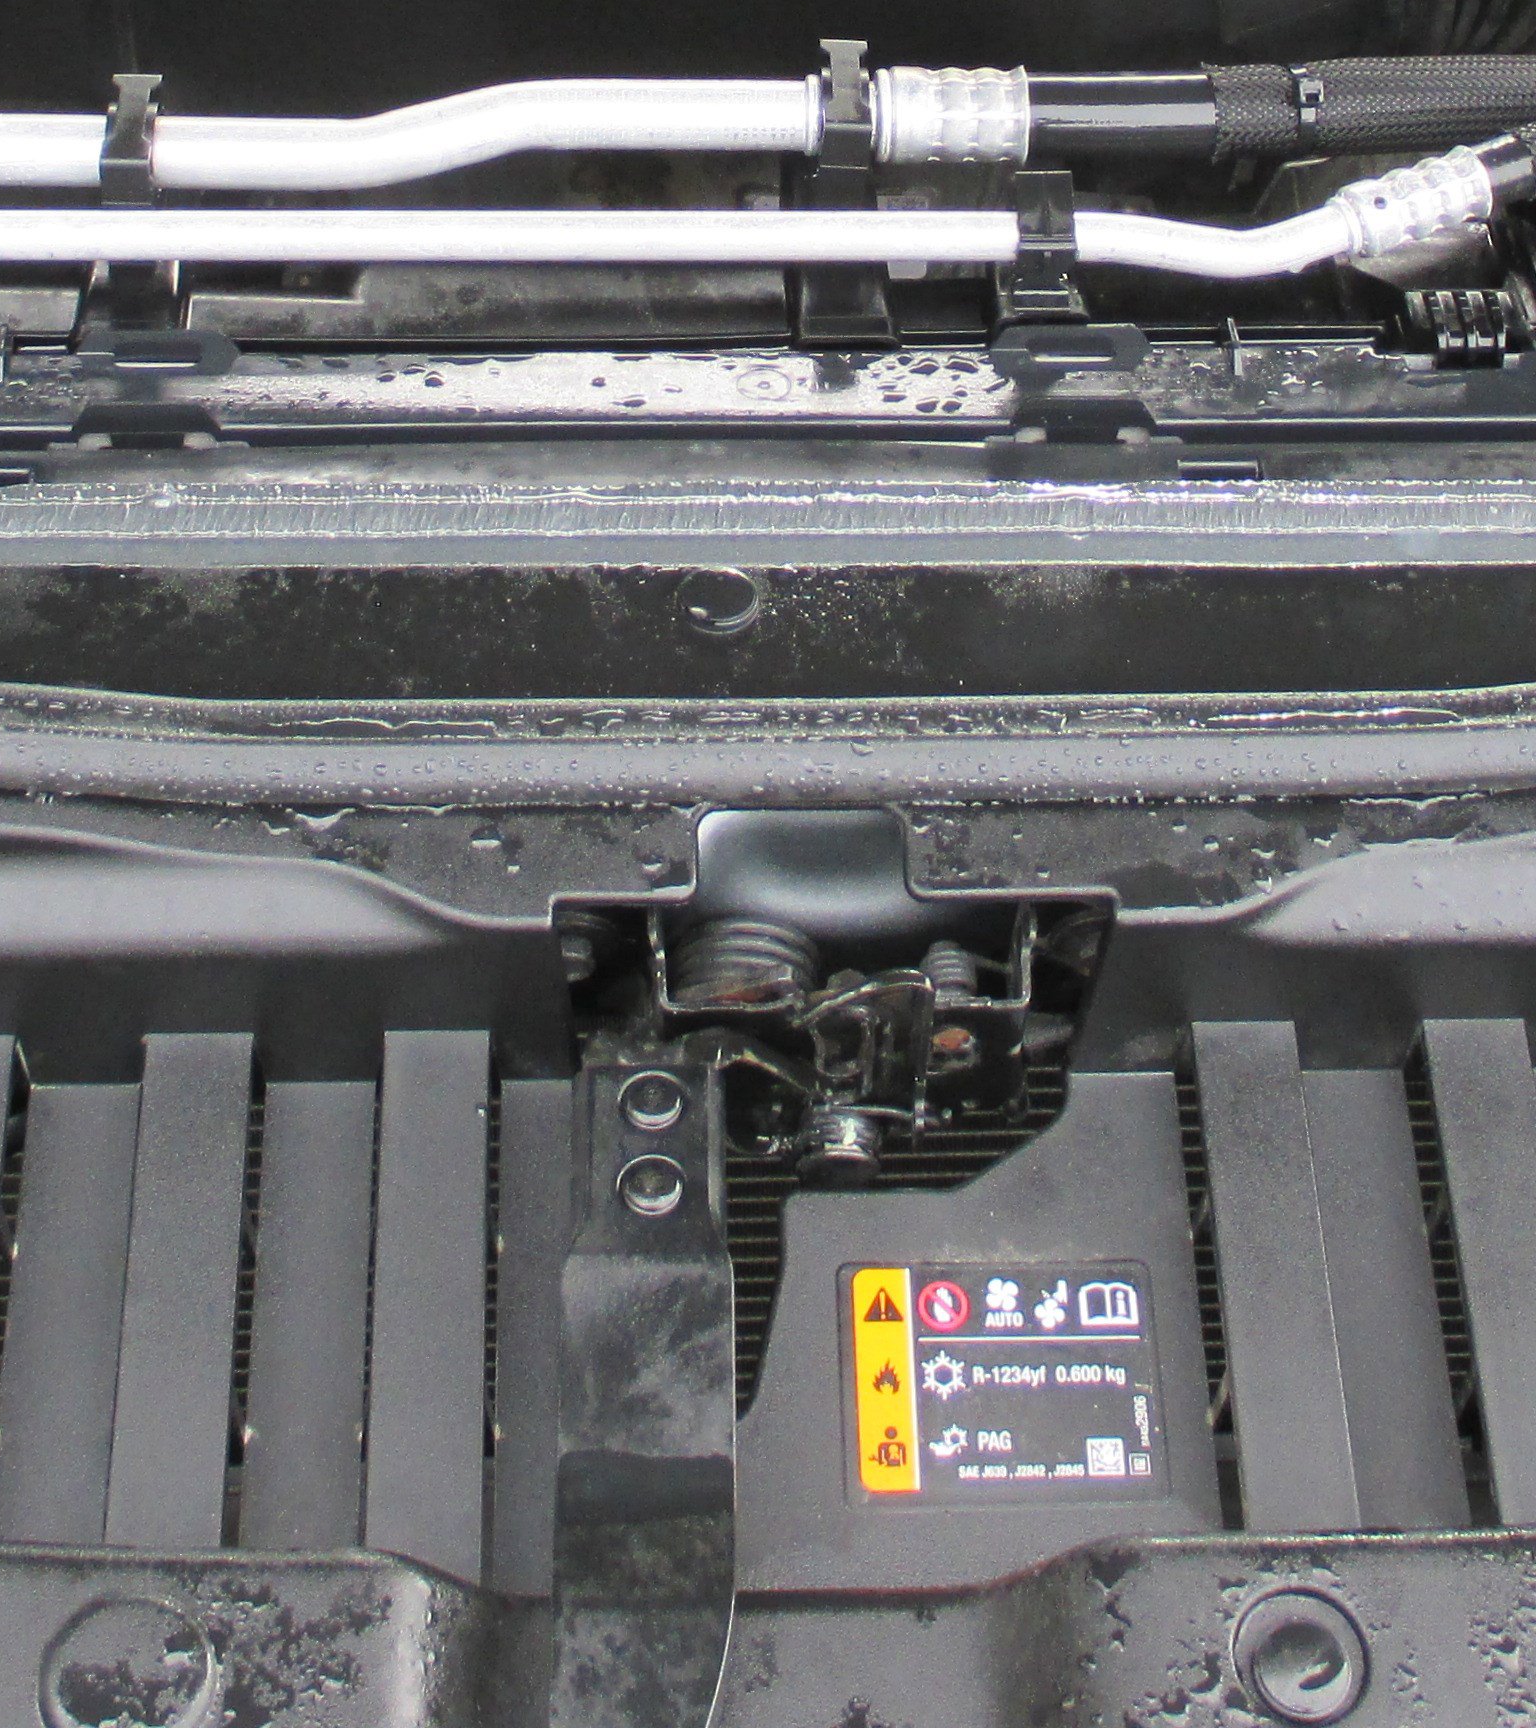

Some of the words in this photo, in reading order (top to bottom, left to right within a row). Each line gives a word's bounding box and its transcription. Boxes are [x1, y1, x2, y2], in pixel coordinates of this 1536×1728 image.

[985, 1311, 1023, 1328] AUTO
[972, 1364, 1047, 1388] R-1234yf
[1055, 1365, 1102, 1384] 0.600
[1105, 1365, 1127, 1387] kg
[977, 1430, 1013, 1452] PAG
[958, 1464, 980, 1479] SAE
